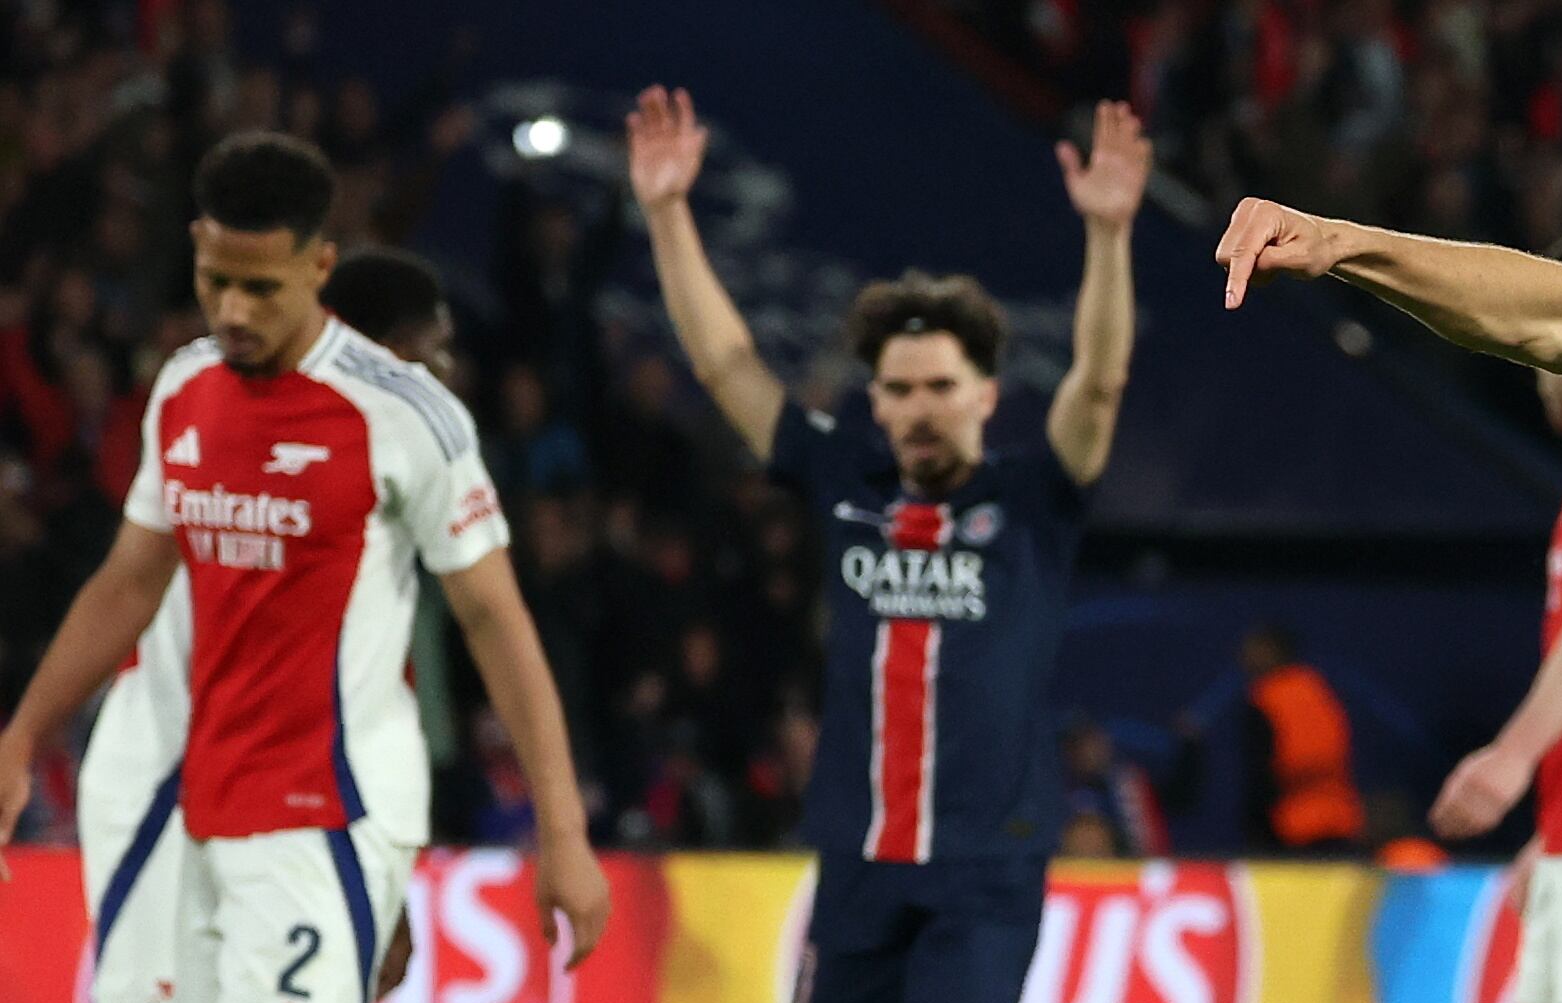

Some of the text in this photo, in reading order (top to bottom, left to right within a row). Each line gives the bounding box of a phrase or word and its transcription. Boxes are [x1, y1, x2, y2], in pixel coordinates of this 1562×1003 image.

[163, 479, 312, 537] Emirates
[840, 545, 986, 599] QATAR
[277, 924, 321, 999] 2
